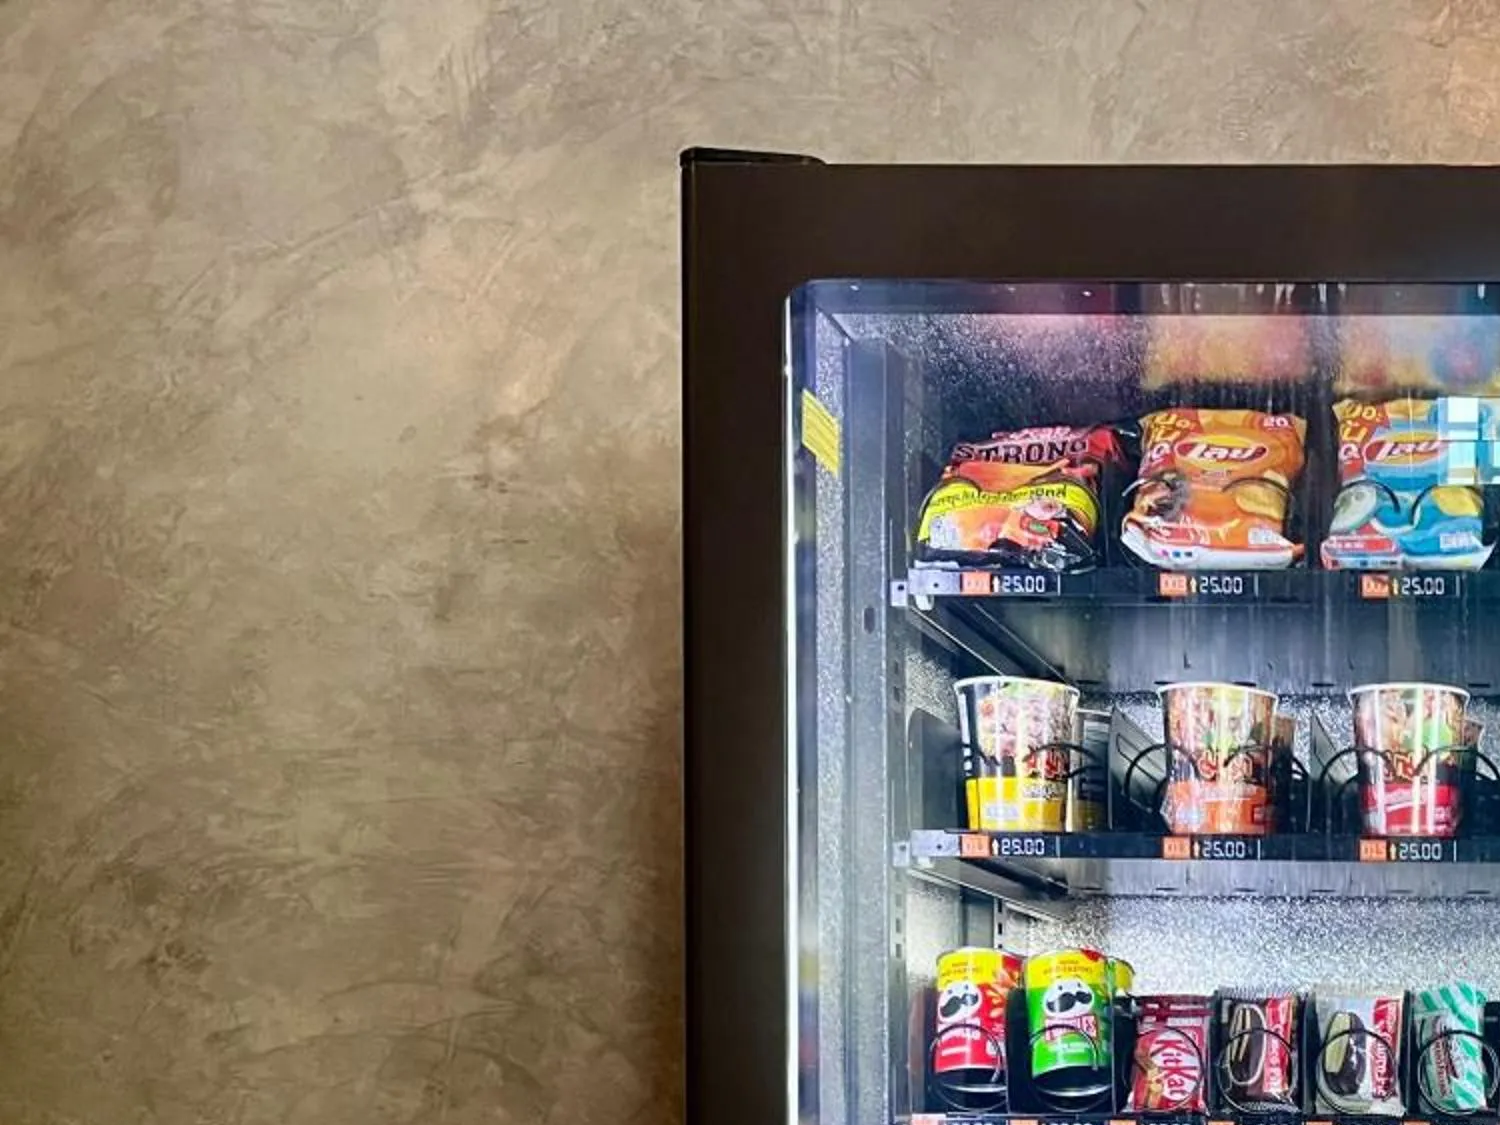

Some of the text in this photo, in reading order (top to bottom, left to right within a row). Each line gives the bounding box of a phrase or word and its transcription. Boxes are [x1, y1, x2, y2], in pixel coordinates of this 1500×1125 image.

[1002, 577, 1045, 593] 25.00
[1200, 578, 1243, 594] 25.00
[1402, 577, 1445, 595] 25.00
[1002, 839, 1045, 855] 25.00
[1202, 841, 1246, 858] 25.00
[1399, 843, 1442, 860] 25.00
